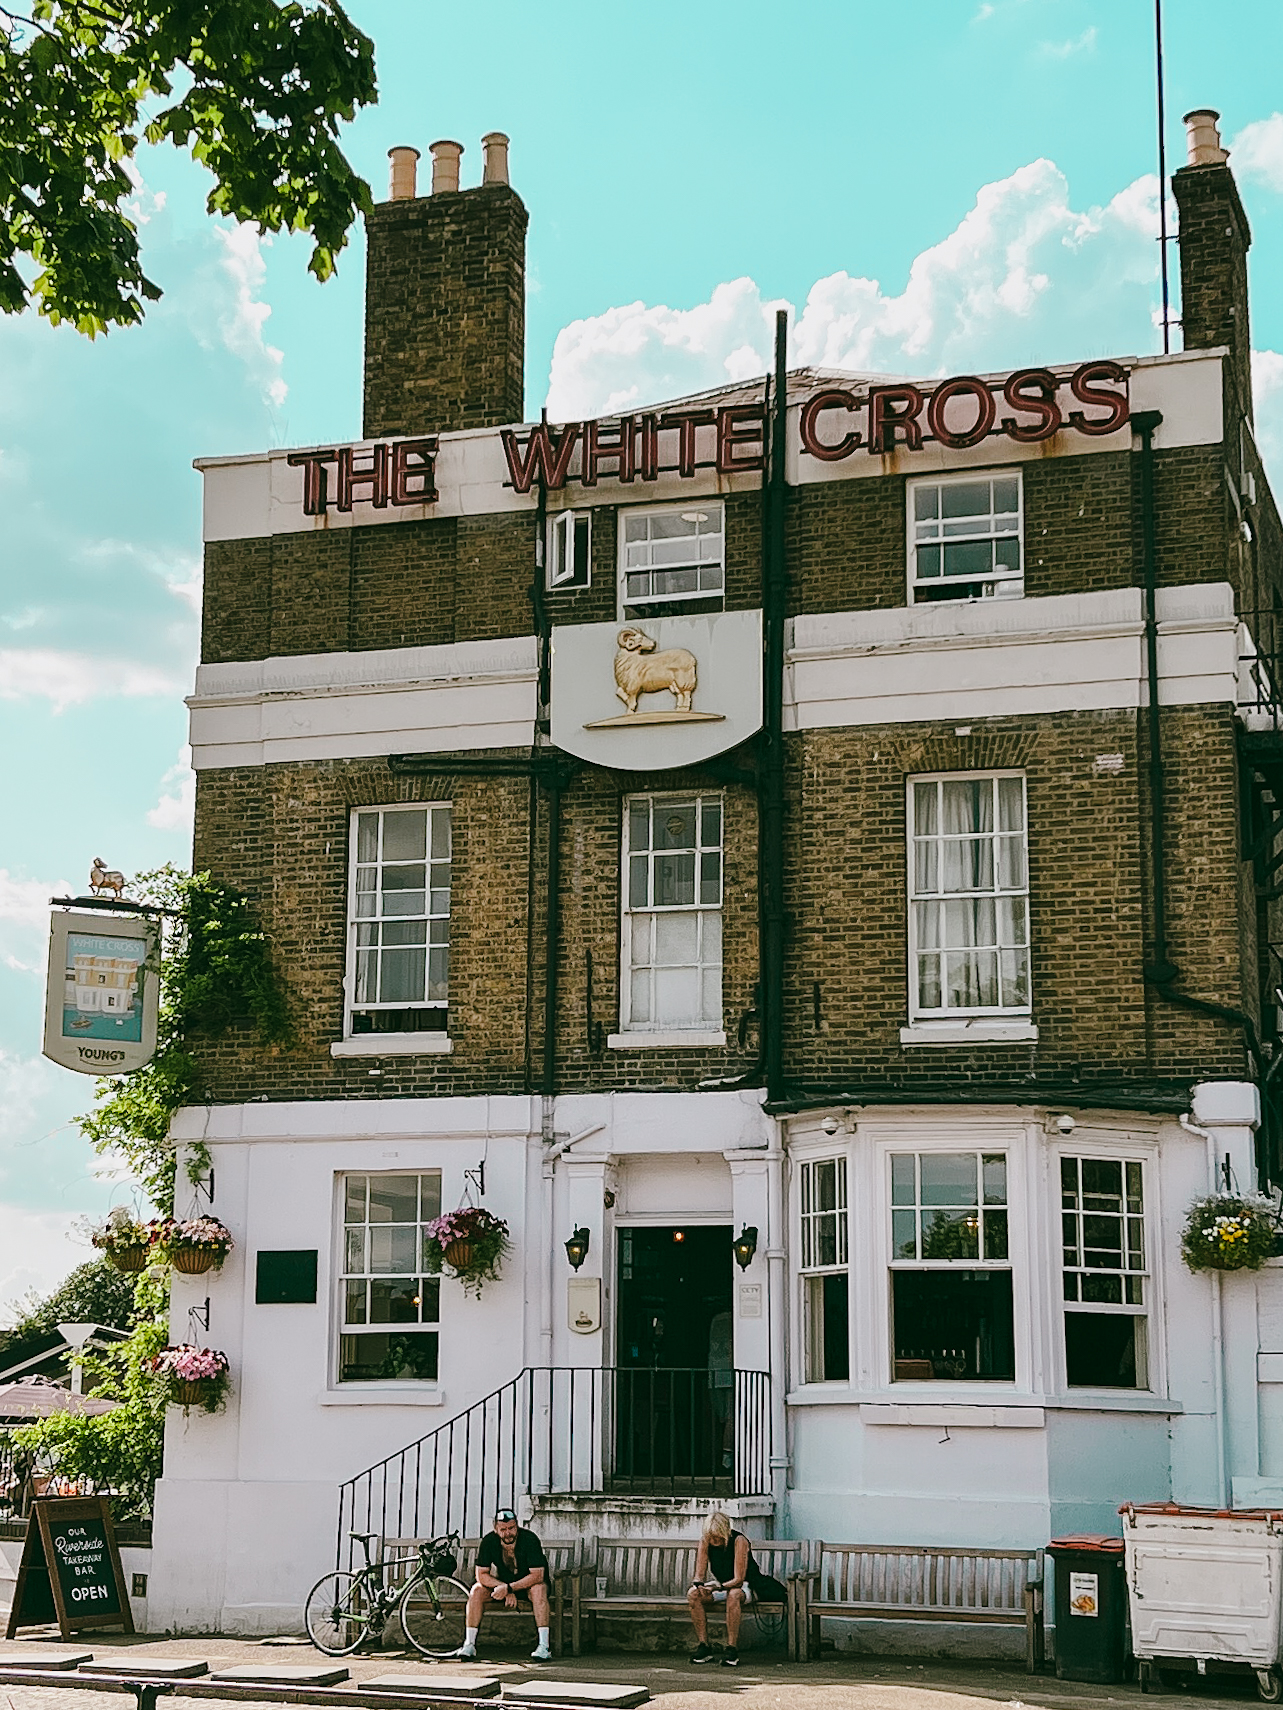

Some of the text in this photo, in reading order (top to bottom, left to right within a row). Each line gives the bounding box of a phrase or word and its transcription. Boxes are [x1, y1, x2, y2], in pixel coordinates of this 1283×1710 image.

[288, 360, 1131, 515] THE WHITE CROSS
[73, 938, 140, 952] WHITE CROSS
[78, 1046, 126, 1061] YOUNG'S
[68, 1528, 87, 1536] OUR
[55, 1536, 104, 1555] Riverside
[63, 1553, 102, 1565] TAKEAWAY
[75, 1566, 96, 1575] BAR
[72, 1585, 108, 1601] OPEN
